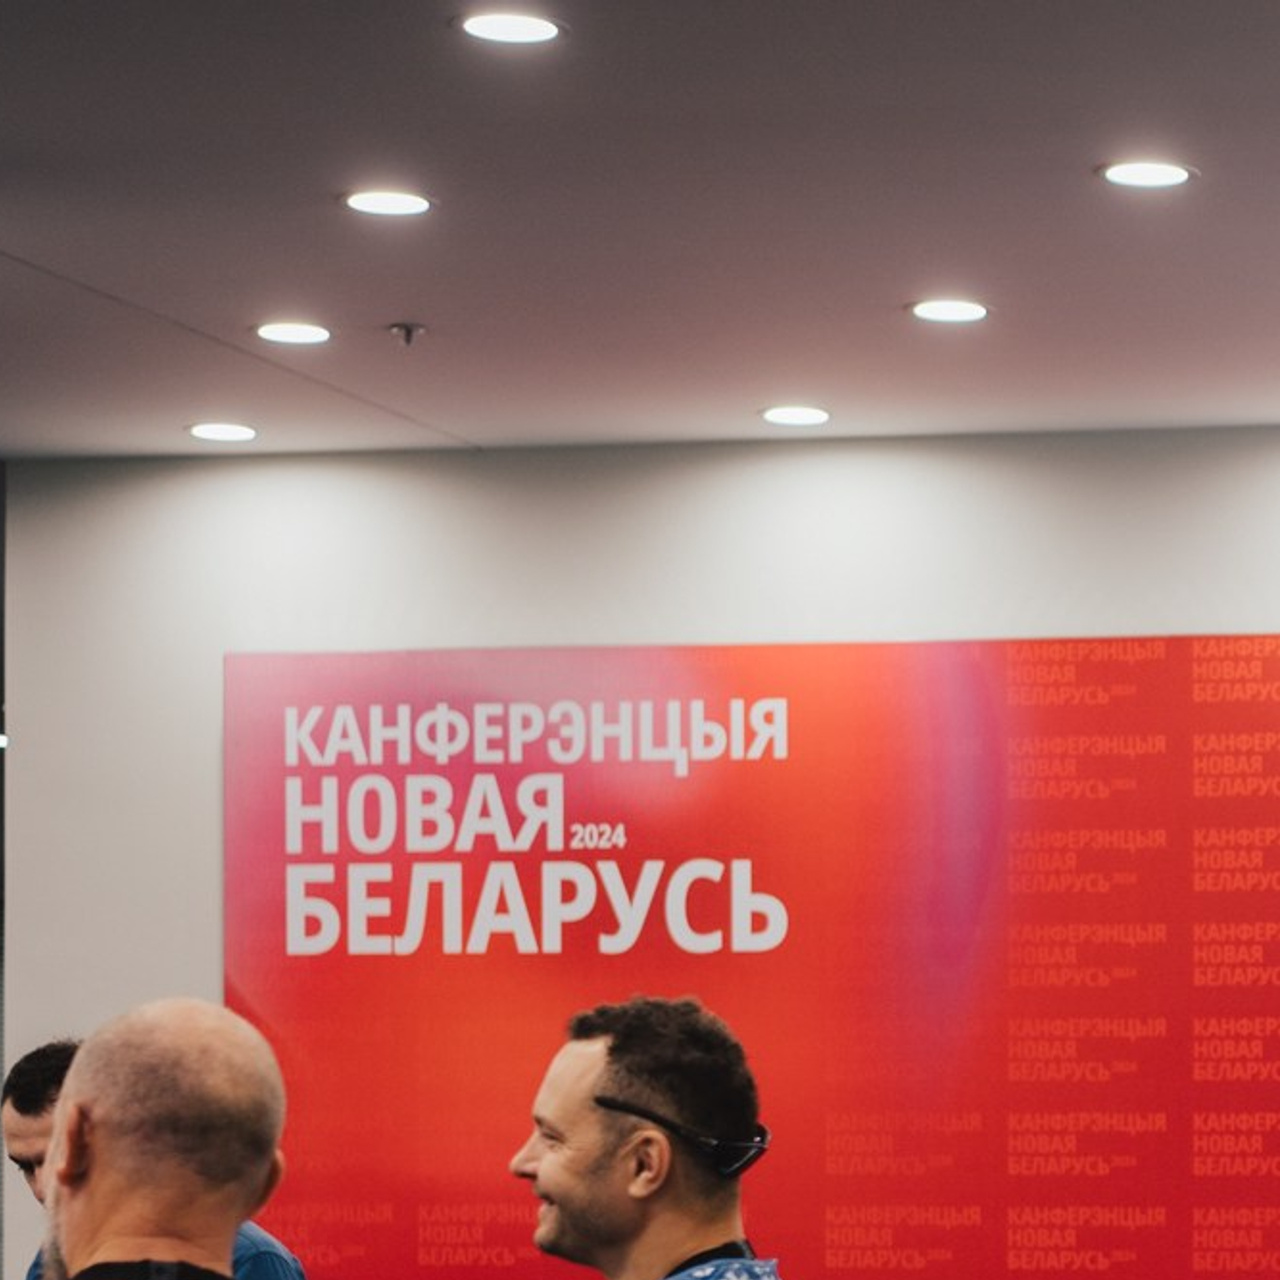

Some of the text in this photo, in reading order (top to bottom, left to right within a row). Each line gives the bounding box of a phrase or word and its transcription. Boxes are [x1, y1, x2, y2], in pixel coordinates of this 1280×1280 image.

[1194, 660, 1262, 680] НОВАЯ
[285, 697, 788, 777] КАНФЕРЭНЦЫЯ
[1194, 755, 1262, 774] НОВАЯ
[285, 773, 627, 854] НОВАЯ 2024
[1194, 849, 1262, 869] НОВАЯ
[285, 858, 789, 955] БЕЛАРУСЬ
[1194, 944, 1262, 964] НОВАЯ
[1194, 1039, 1262, 1058] НОВАЯ
[1194, 1134, 1262, 1153] НОВАЯ
[1194, 1229, 1262, 1248] НОВАЯ
